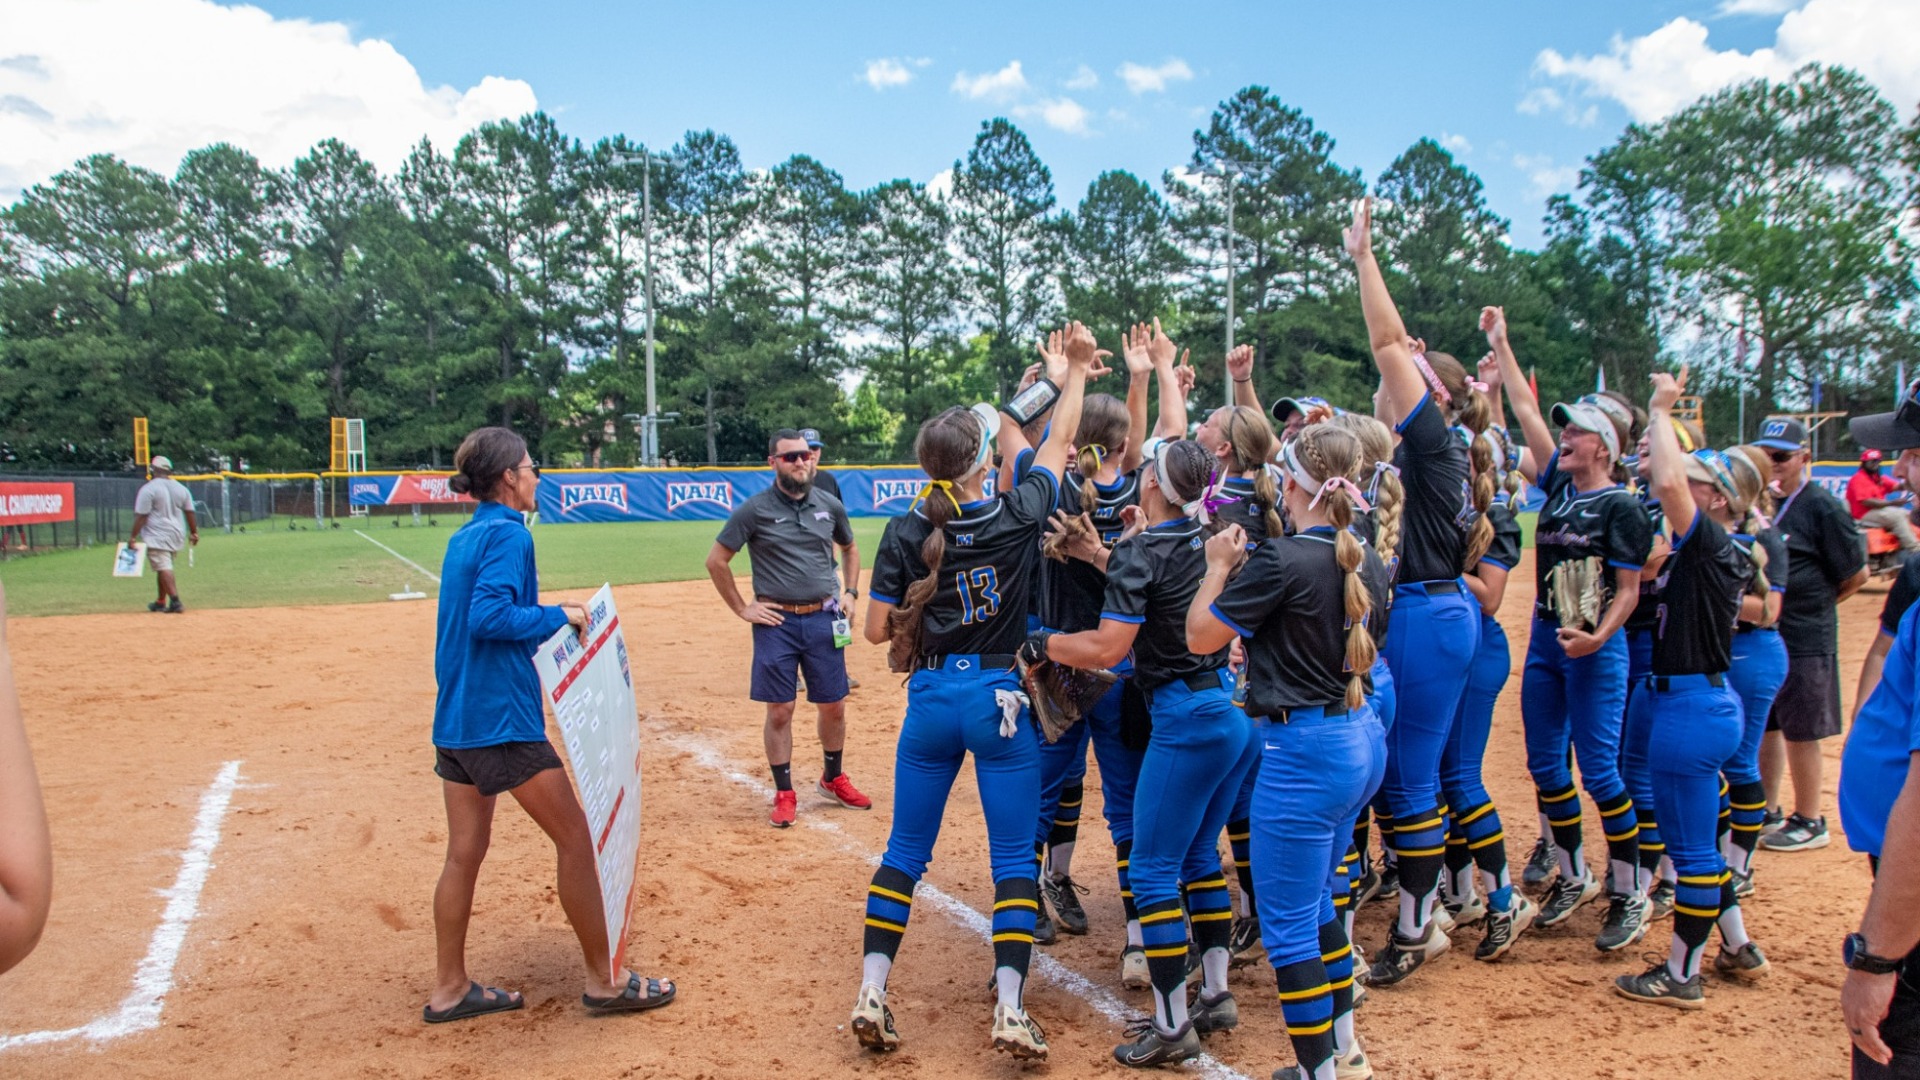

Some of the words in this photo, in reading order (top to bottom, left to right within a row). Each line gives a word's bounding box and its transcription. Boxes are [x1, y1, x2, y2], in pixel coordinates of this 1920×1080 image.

[1763, 421, 1789, 437] M
[563, 484, 627, 513] NAIA
[668, 482, 732, 511] NAIA
[1094, 506, 1115, 518] M
[956, 533, 974, 547] M
[956, 565, 1001, 625] 13
